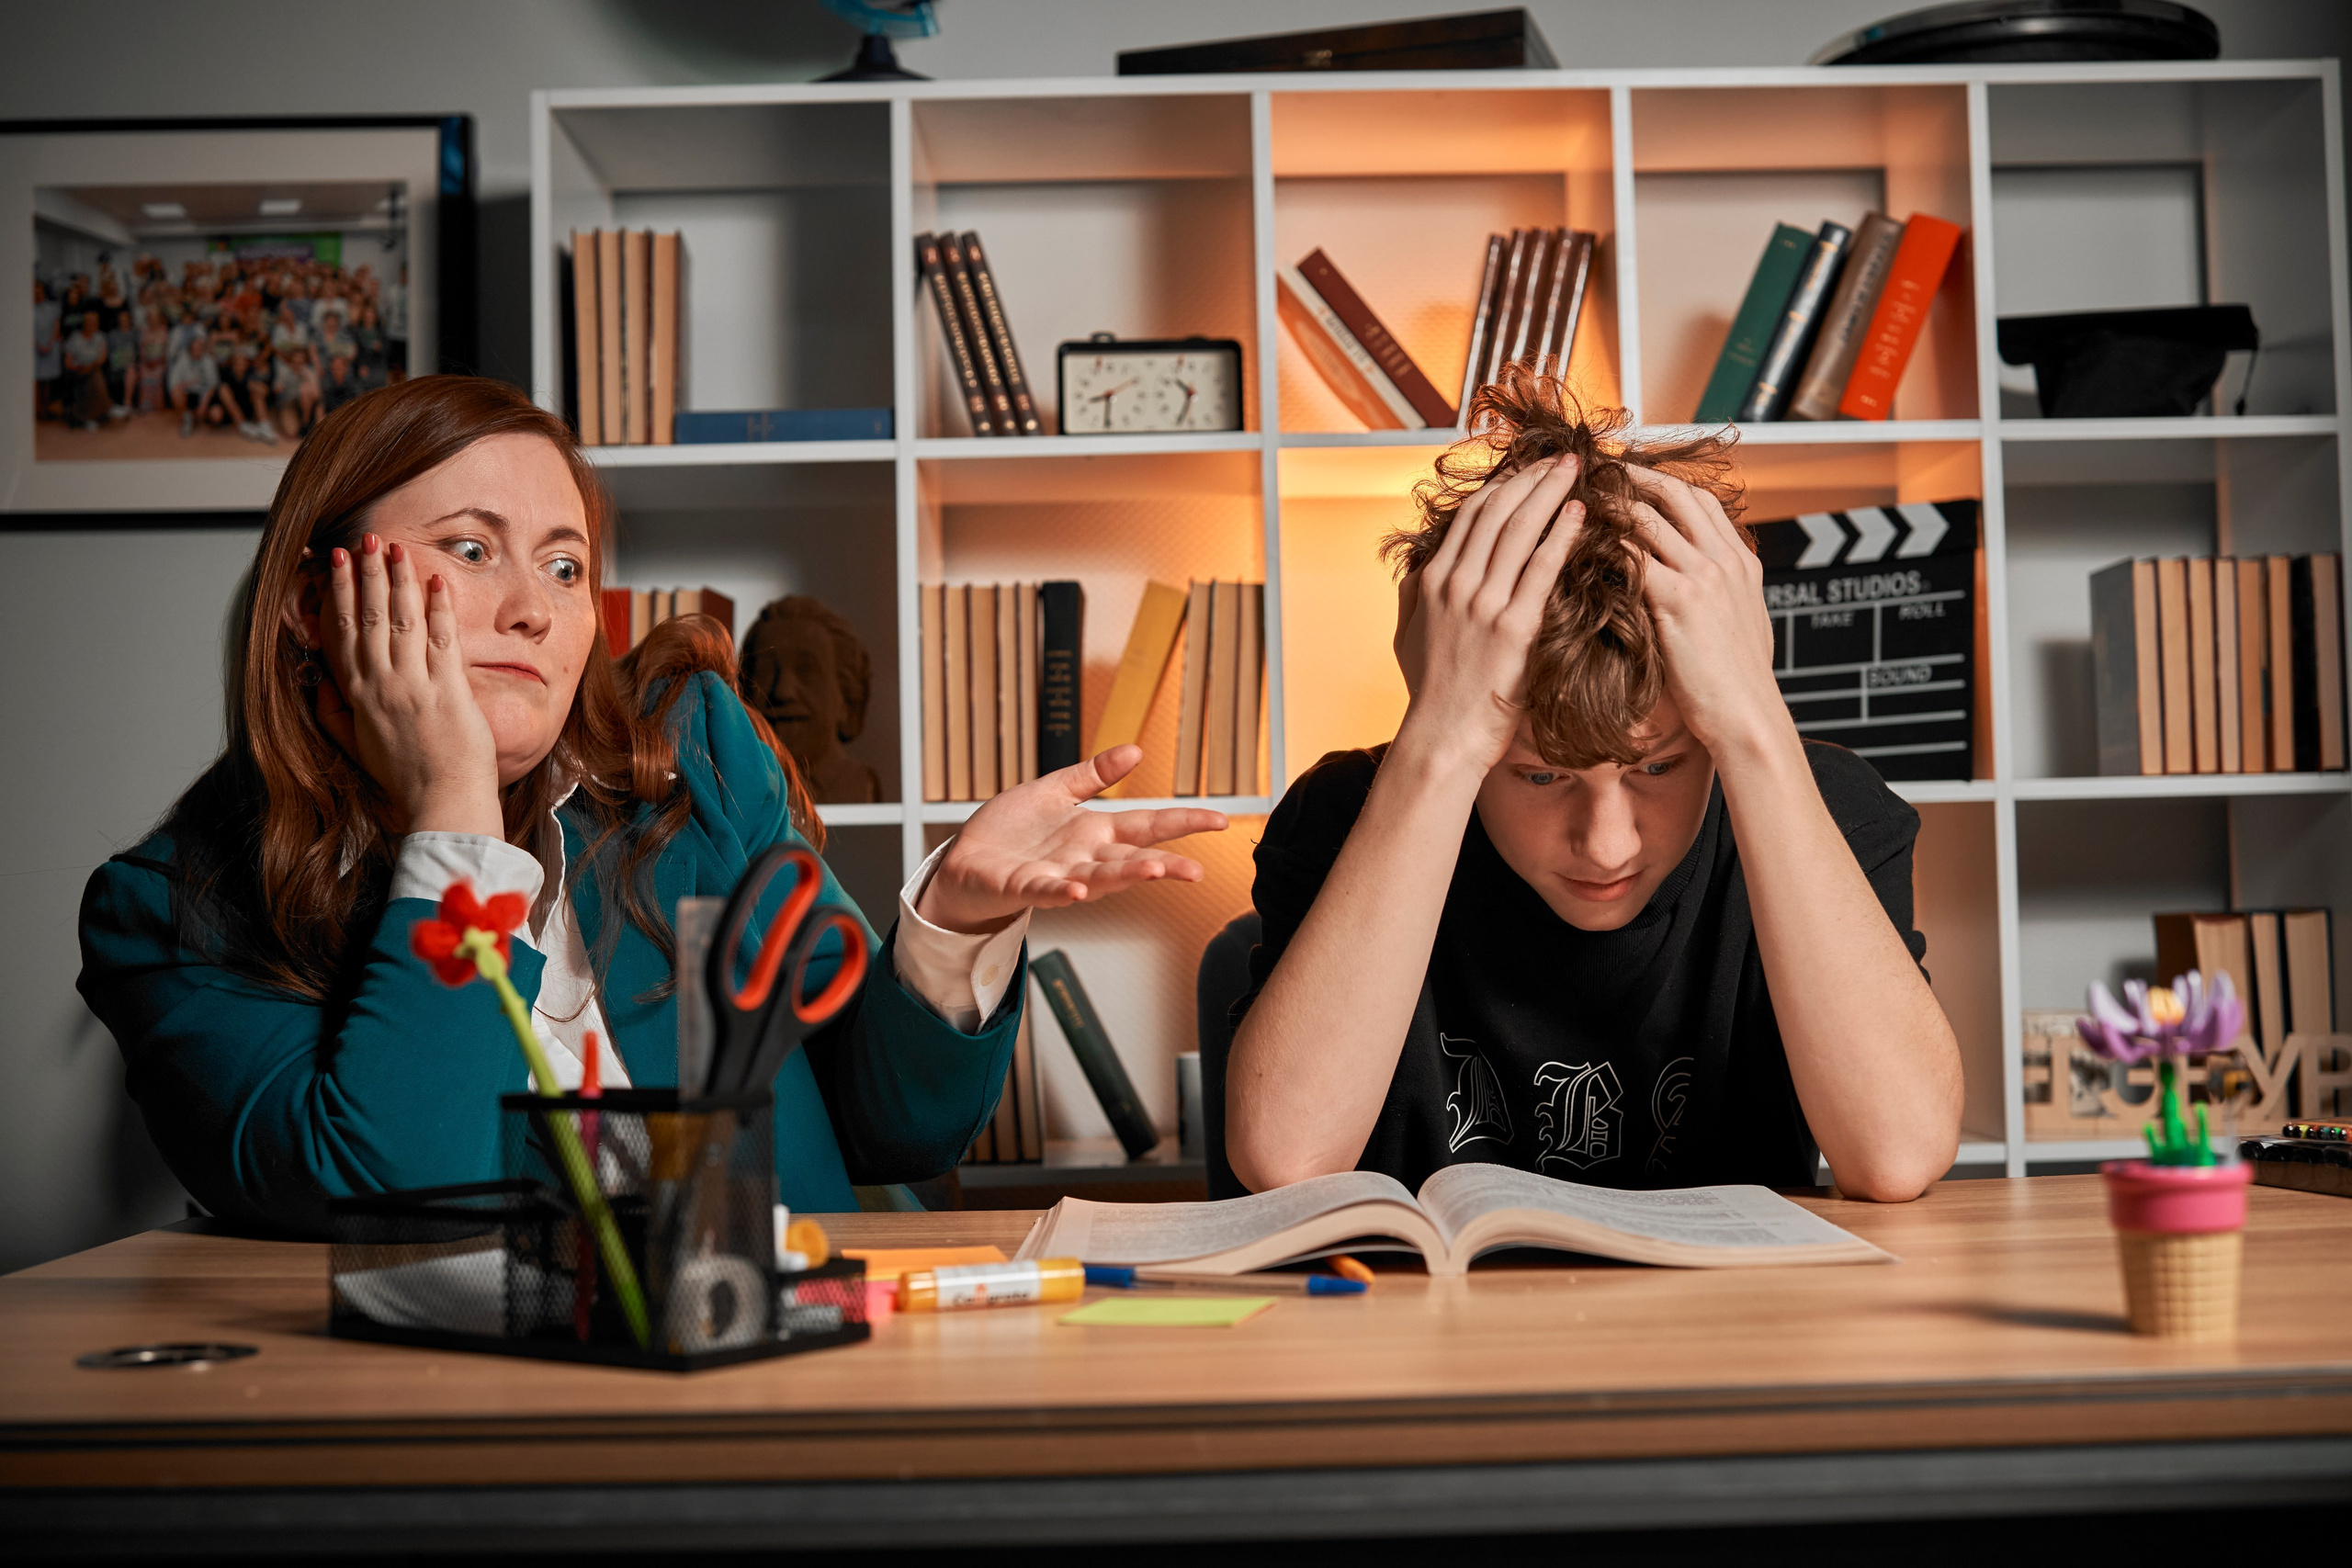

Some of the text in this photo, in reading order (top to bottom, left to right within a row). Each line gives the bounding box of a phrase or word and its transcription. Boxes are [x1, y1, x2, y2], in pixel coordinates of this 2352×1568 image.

[1826, 570, 1921, 603] STUDIOS
[1811, 611, 1854, 629] TAKE
[1898, 602, 1946, 620] ROLL
[1868, 664, 1932, 687] SOUND
